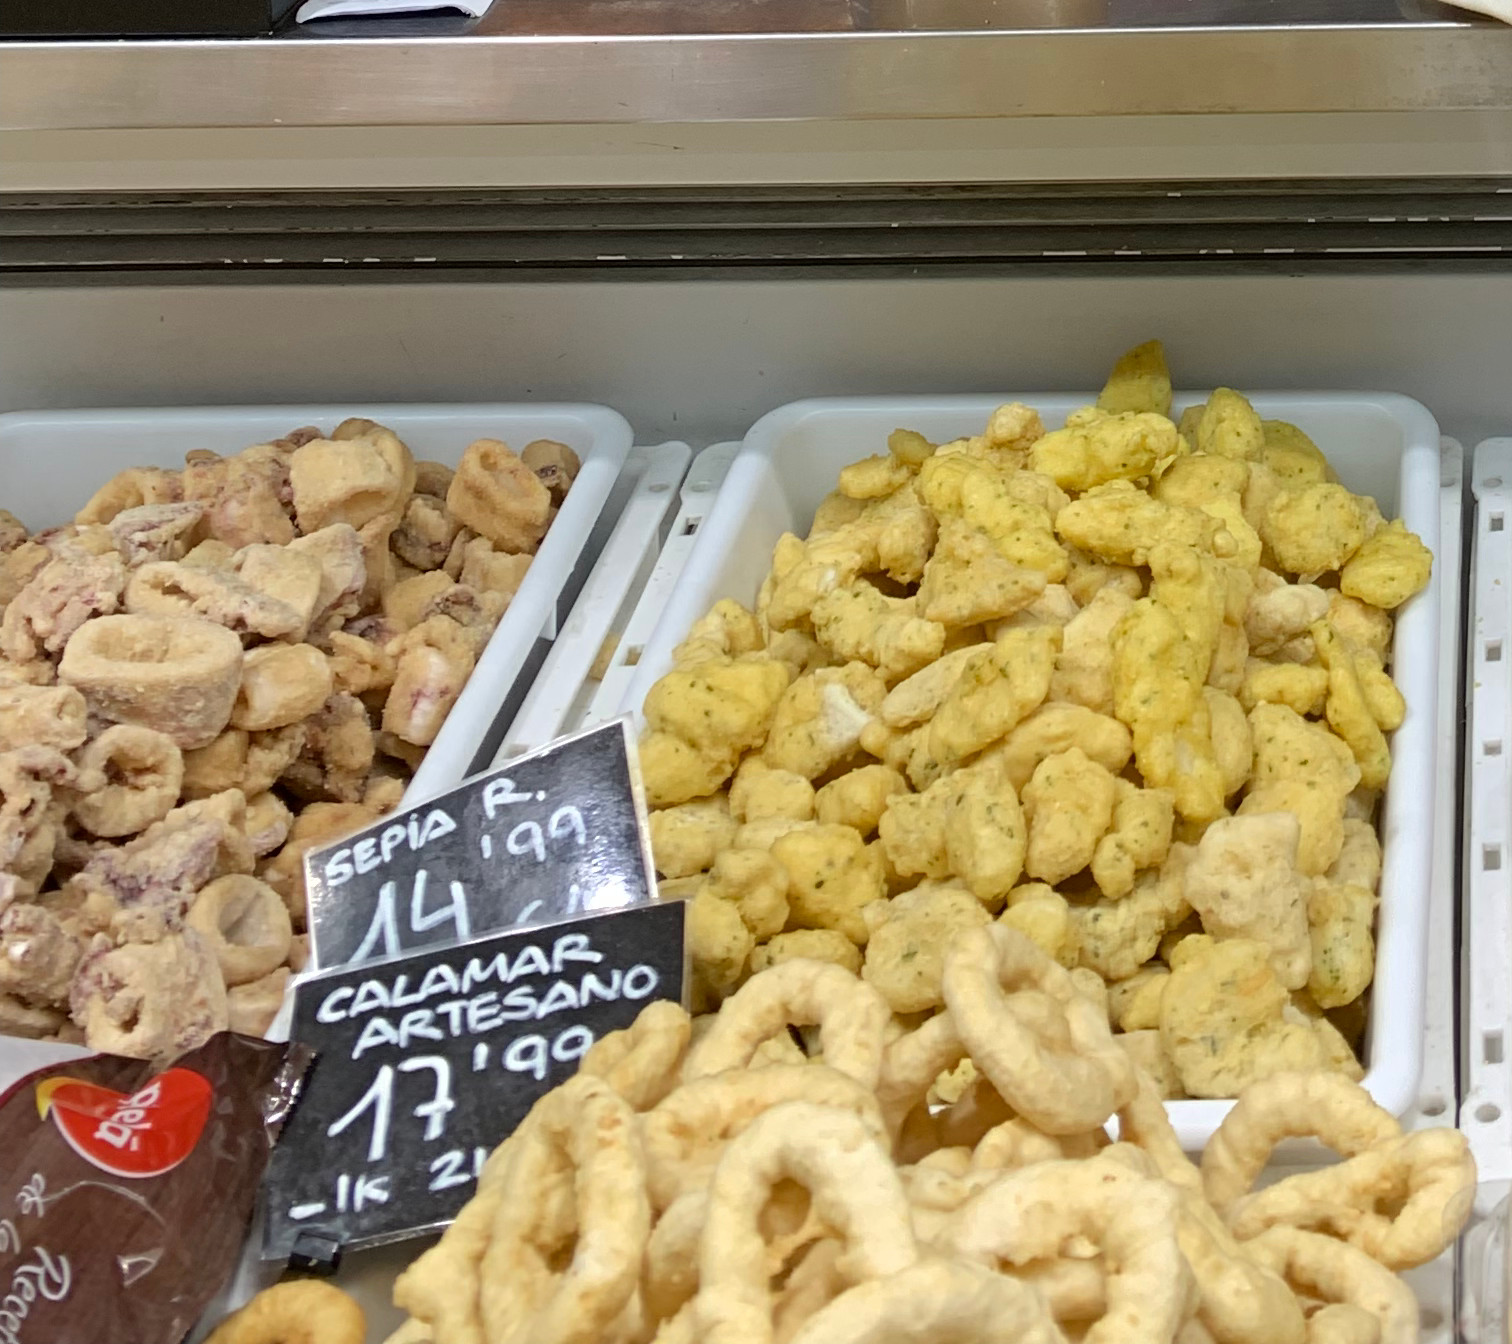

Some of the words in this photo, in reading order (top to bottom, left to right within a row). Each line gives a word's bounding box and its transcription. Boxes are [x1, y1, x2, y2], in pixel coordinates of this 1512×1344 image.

[481, 777, 546, 821] R.
[316, 932, 604, 1024] CALAMAR
[350, 964, 660, 1061] ARTESANO
